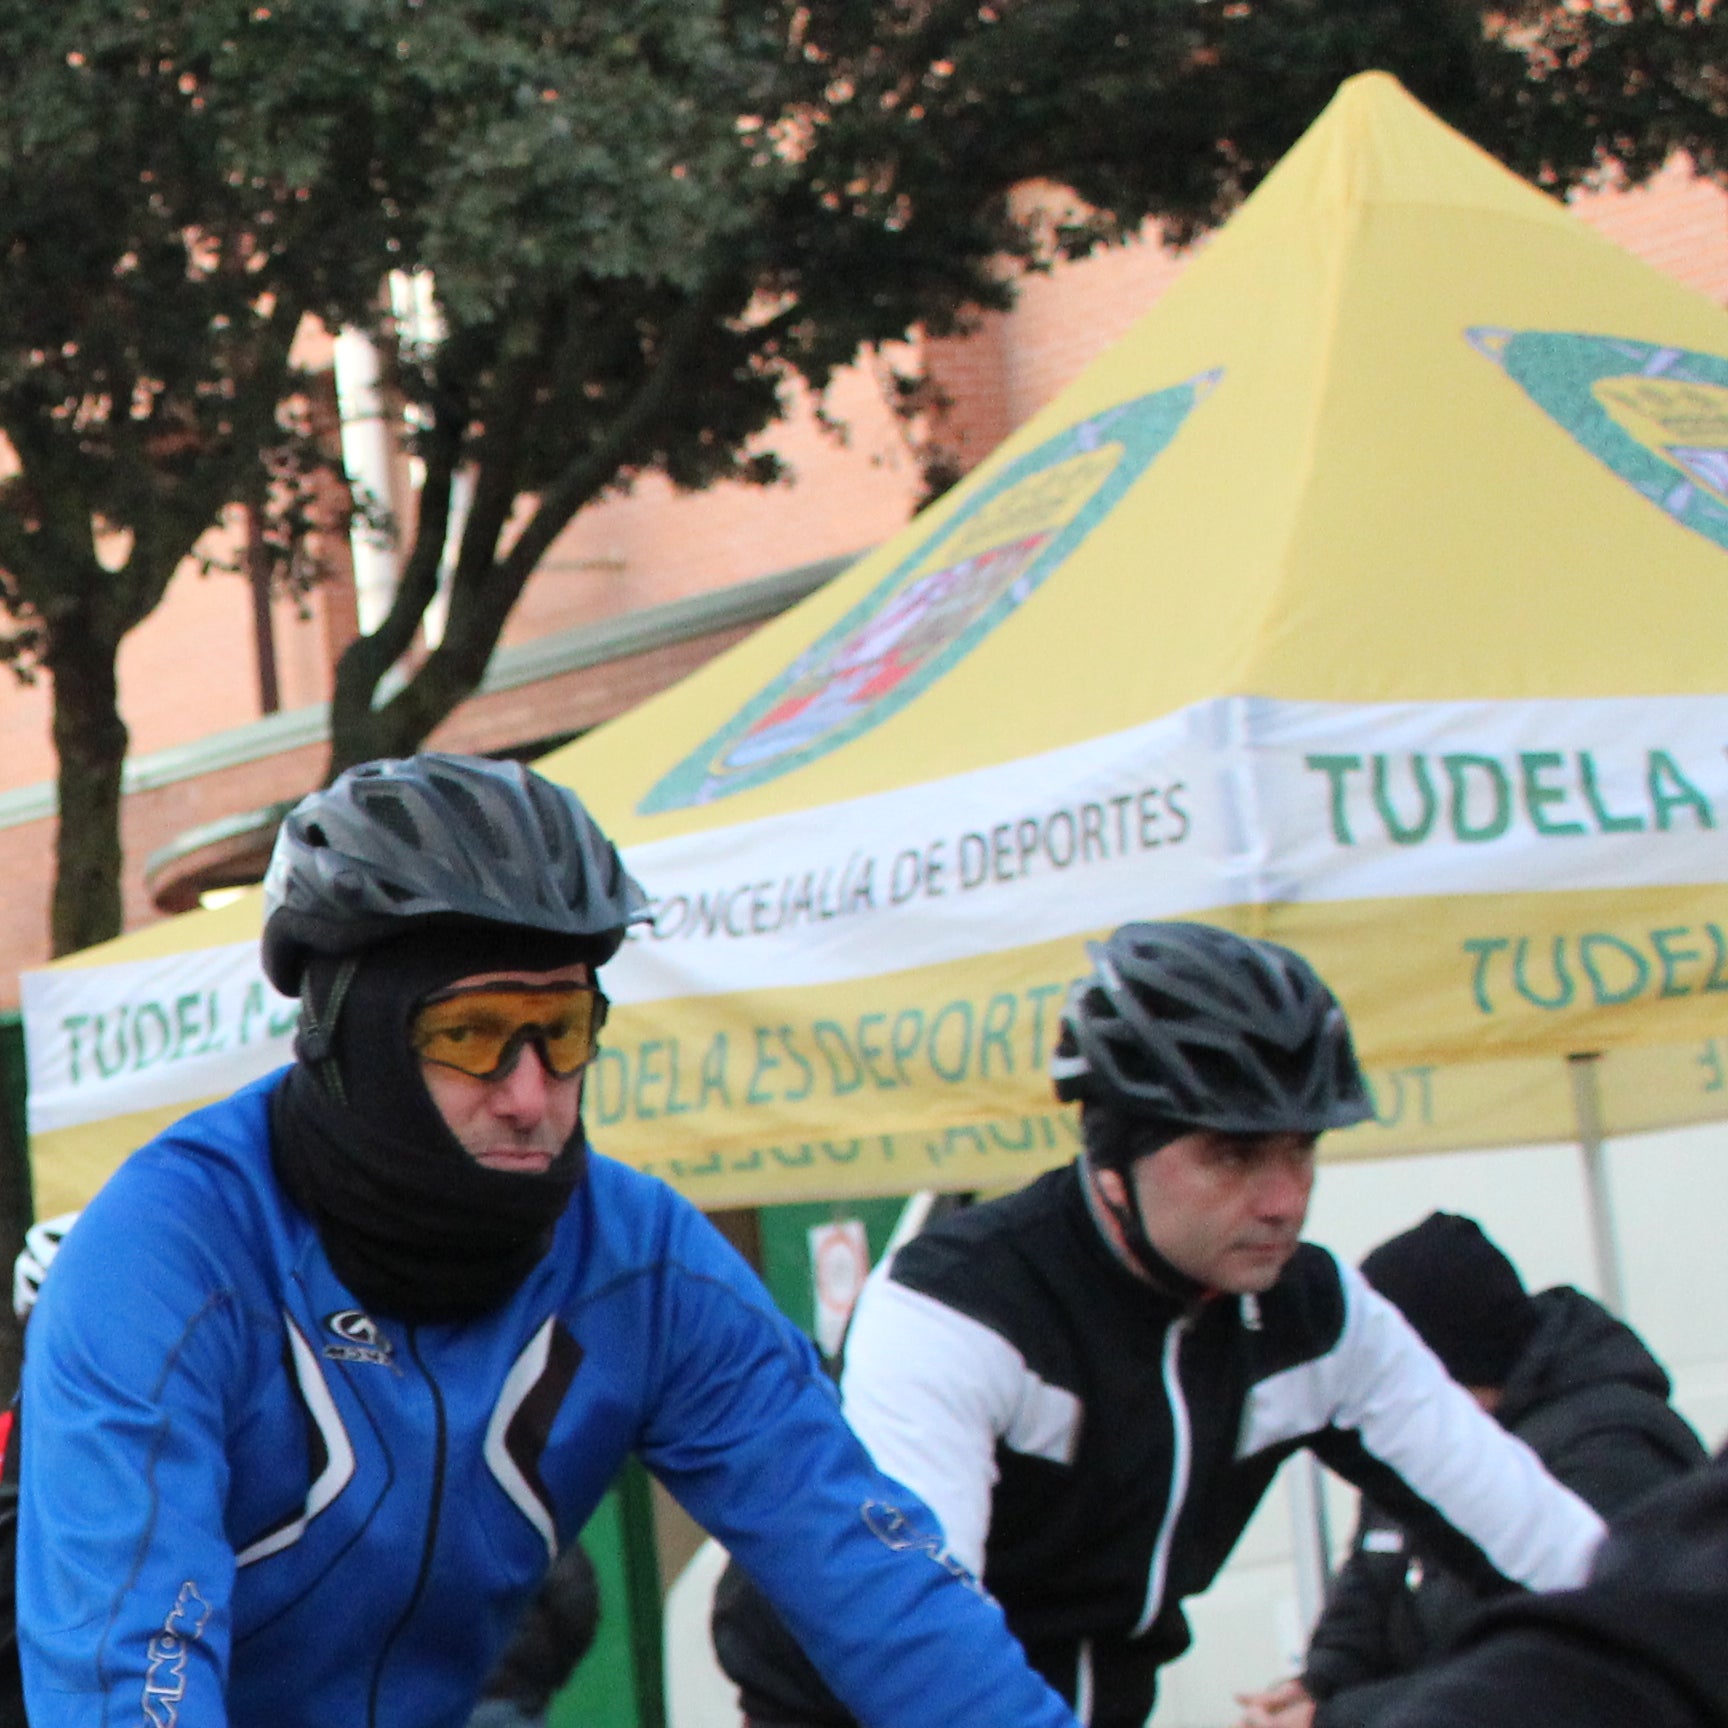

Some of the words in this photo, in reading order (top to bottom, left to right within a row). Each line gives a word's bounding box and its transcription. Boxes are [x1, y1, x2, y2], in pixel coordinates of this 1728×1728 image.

[890, 842, 943, 904] DE
[958, 782, 1190, 891] DEPORTES
[1304, 748, 1717, 847] TUDELA
[590, 1028, 731, 1127] DELA
[747, 1022, 815, 1106] ES
[815, 981, 1062, 1096] DEPORT
